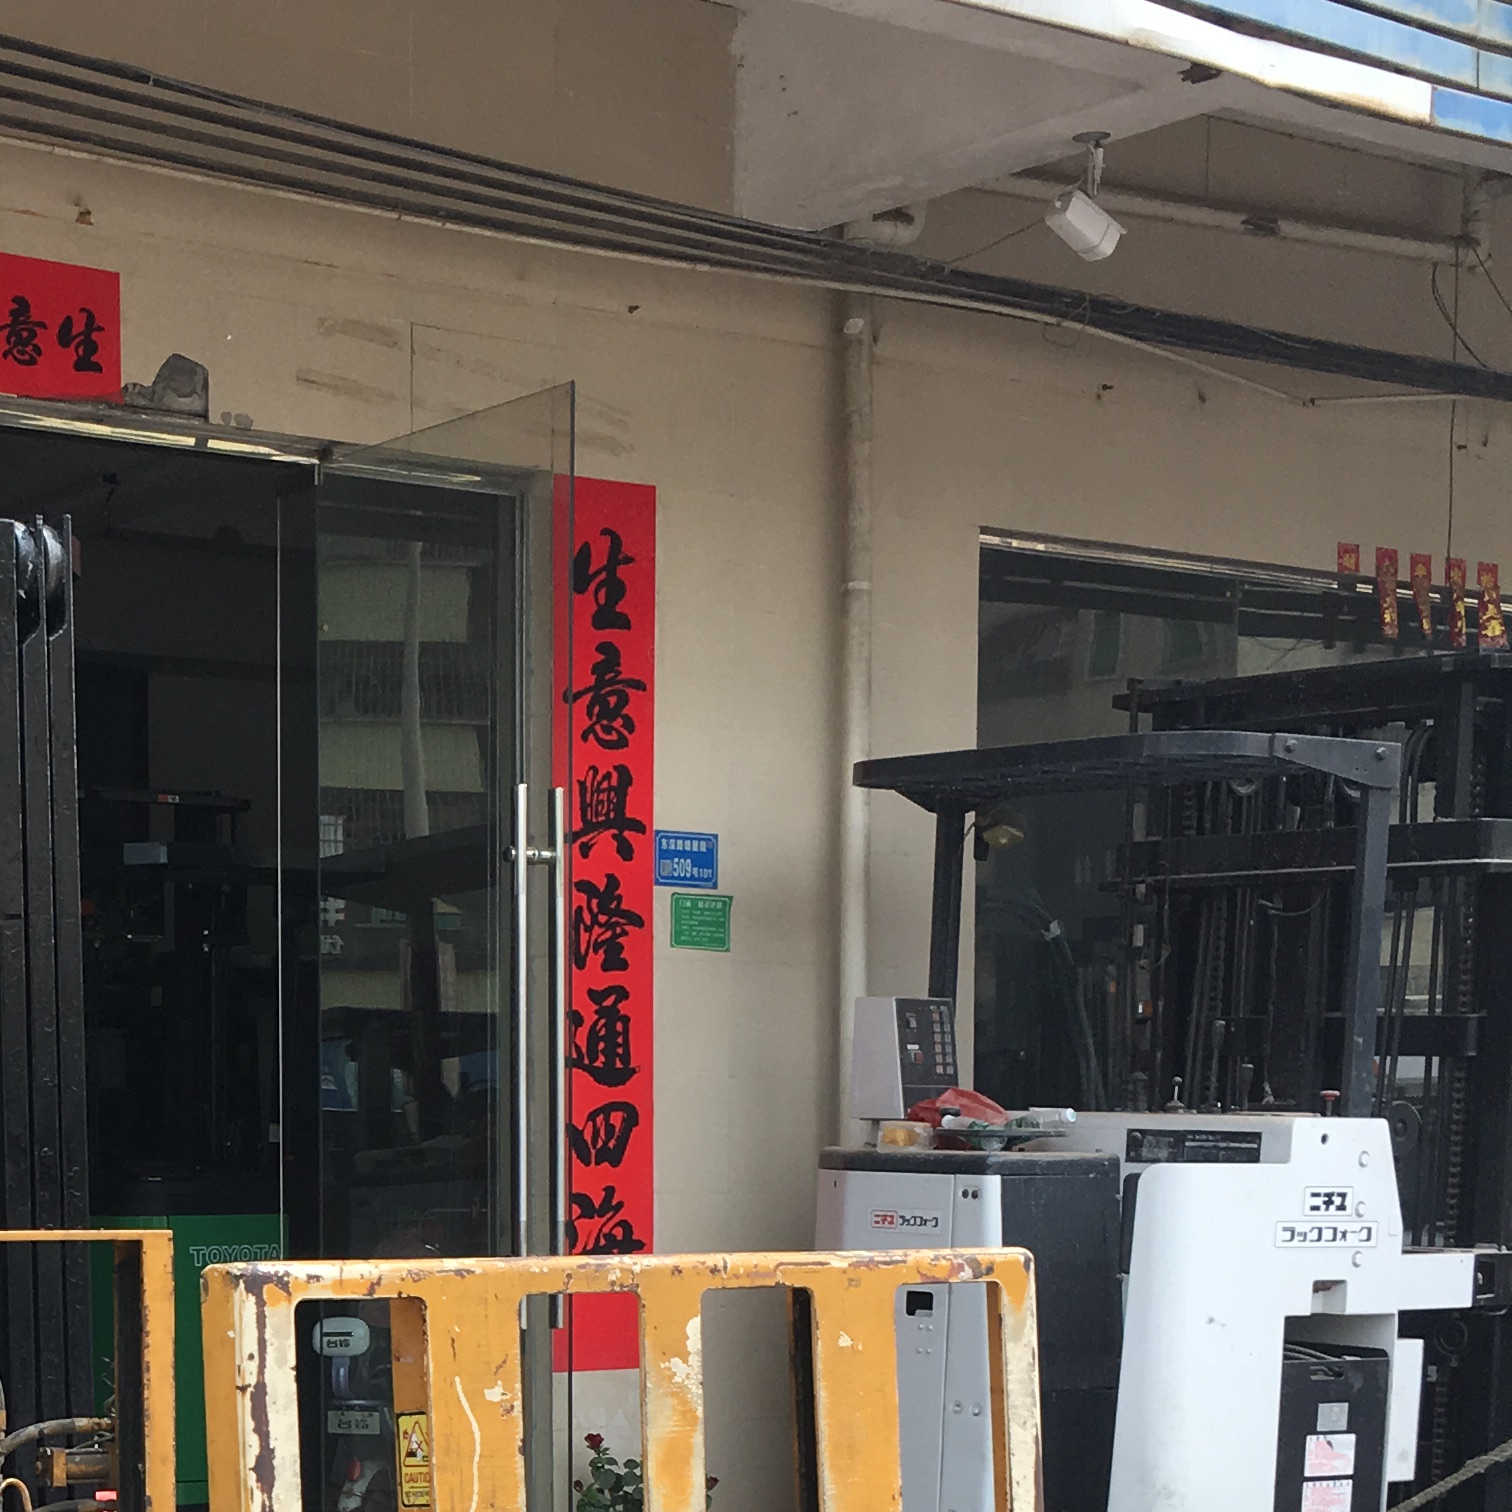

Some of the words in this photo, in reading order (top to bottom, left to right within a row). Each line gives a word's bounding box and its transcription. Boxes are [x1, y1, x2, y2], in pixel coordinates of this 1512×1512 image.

[1281, 1226, 1372, 1243] ラックフォーク
[189, 1244, 281, 1267] TOYOTA
[404, 1472, 430, 1484] CAUTIO
